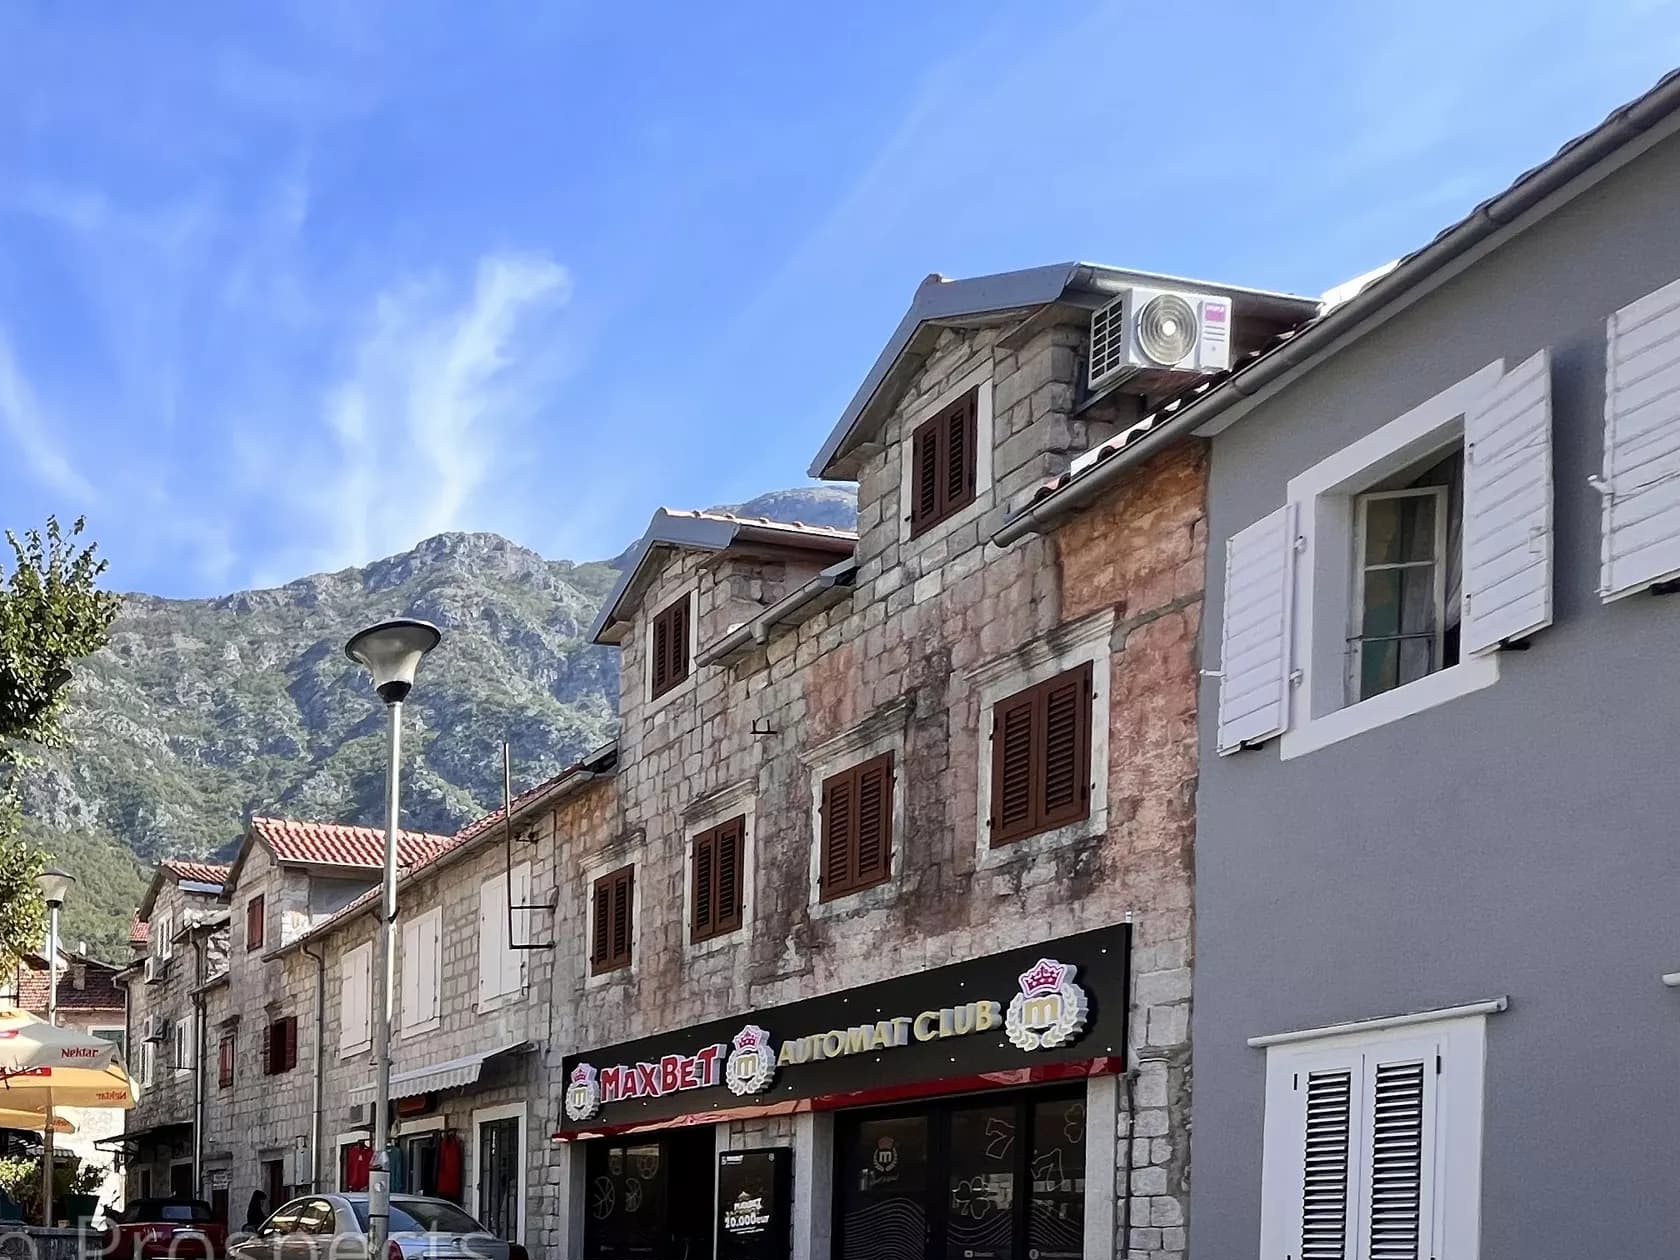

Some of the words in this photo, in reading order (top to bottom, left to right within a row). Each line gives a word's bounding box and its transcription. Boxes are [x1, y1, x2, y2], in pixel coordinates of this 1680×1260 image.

[61, 1048, 98, 1058] Nektar
[777, 1017, 912, 1066] AUTOMAT
[914, 1000, 1002, 1042] CLUB
[600, 1044, 724, 1103] MAXBET
